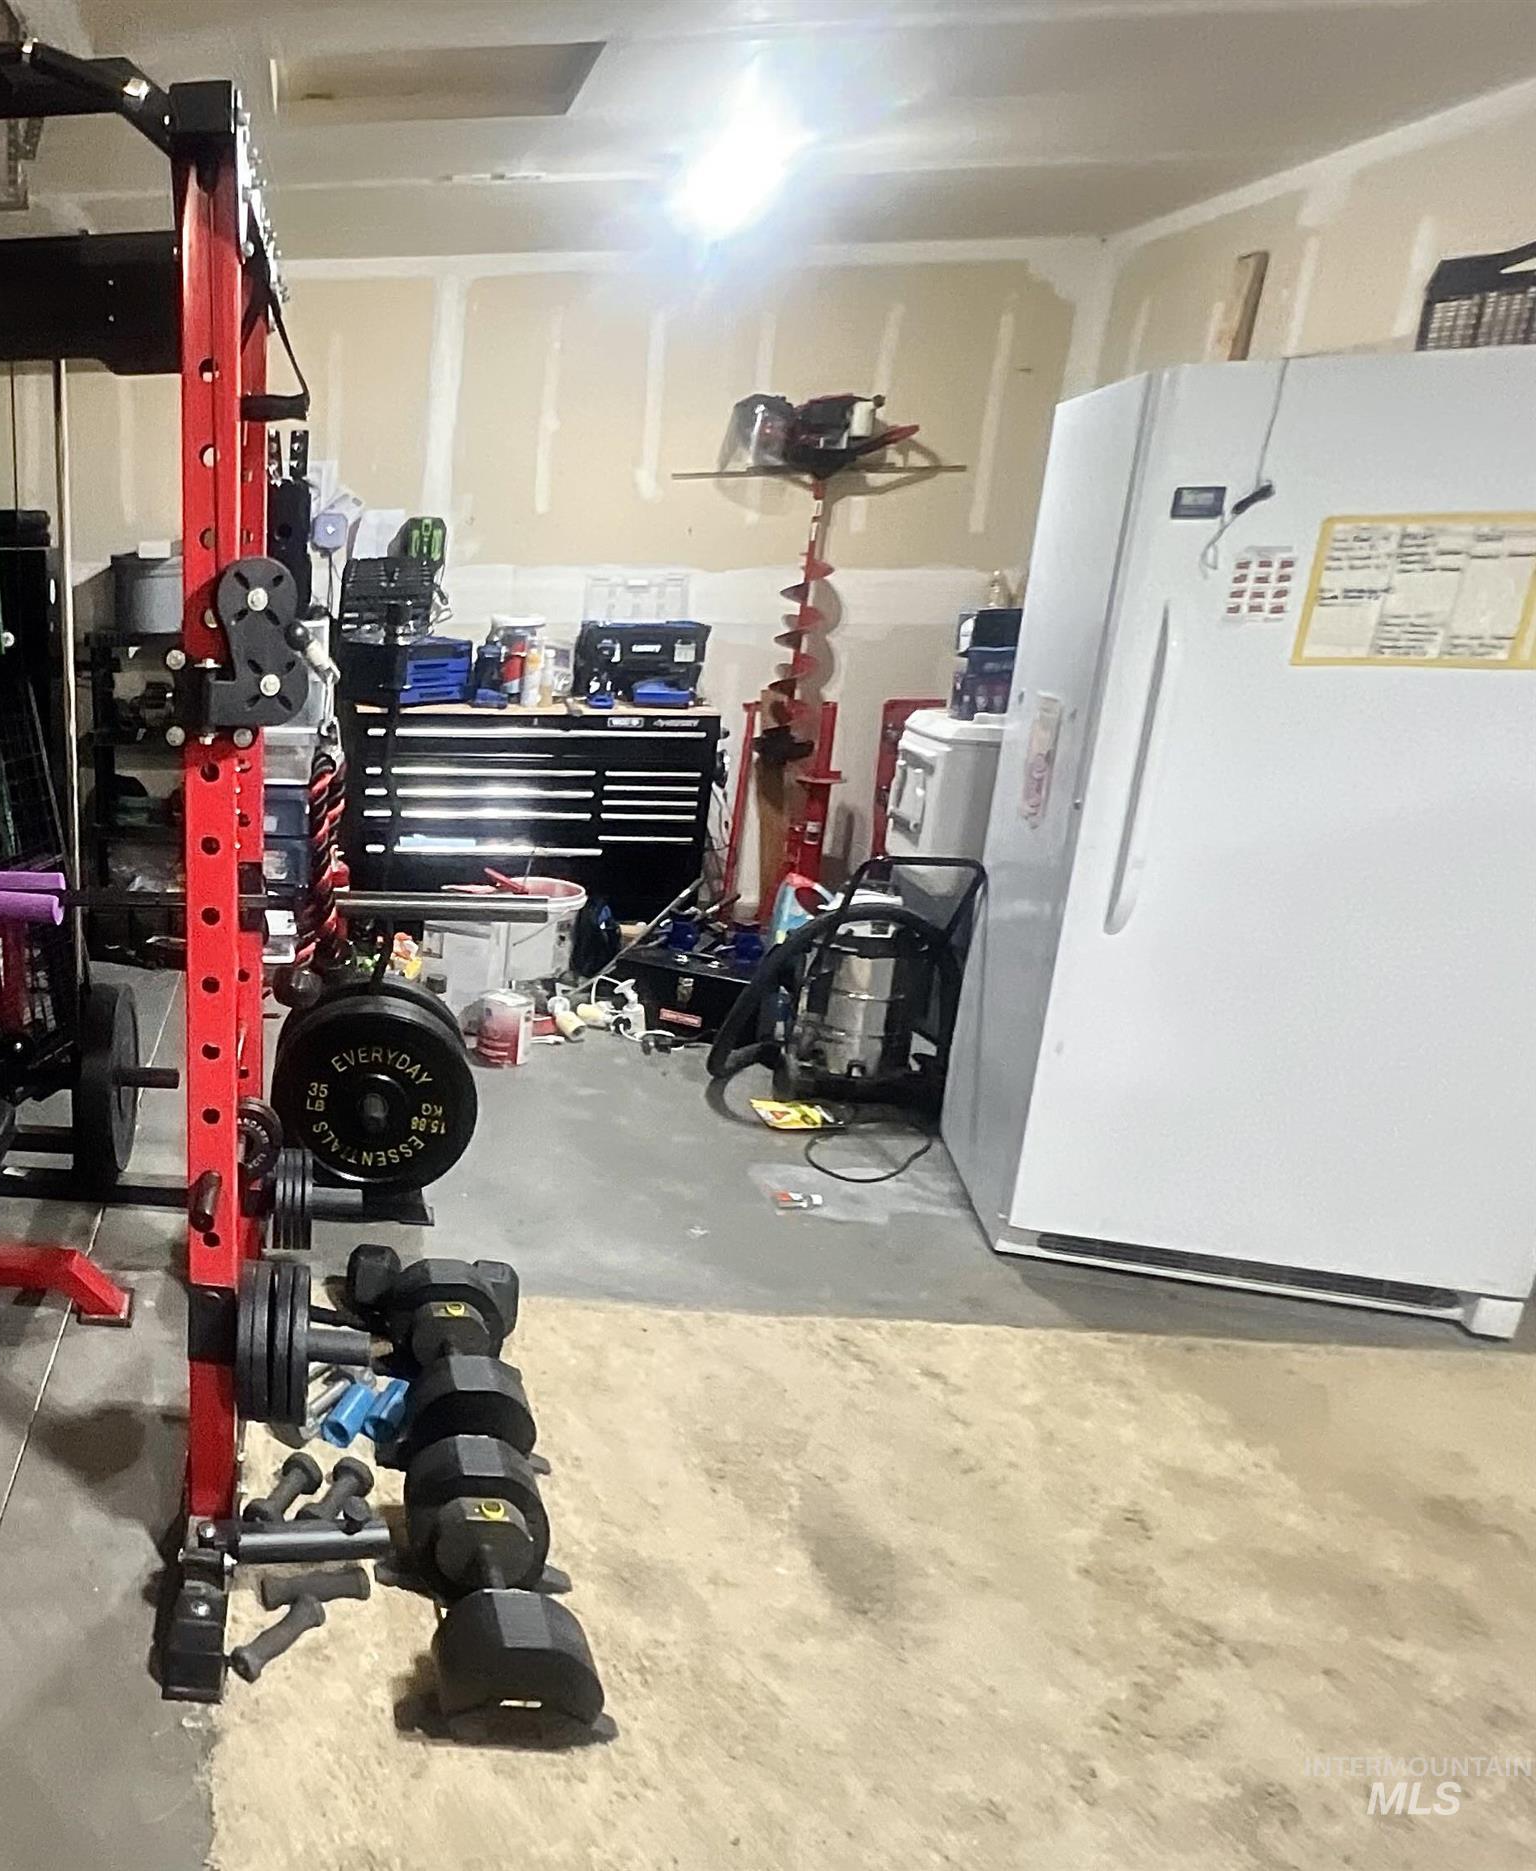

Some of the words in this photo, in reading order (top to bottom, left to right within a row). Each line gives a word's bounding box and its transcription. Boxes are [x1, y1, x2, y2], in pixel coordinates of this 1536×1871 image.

[331, 1047, 433, 1085] EVERYDAY
[308, 1083, 329, 1098] 35
[306, 1099, 326, 1112] LB
[312, 1121, 426, 1167] ESSENTIALS
